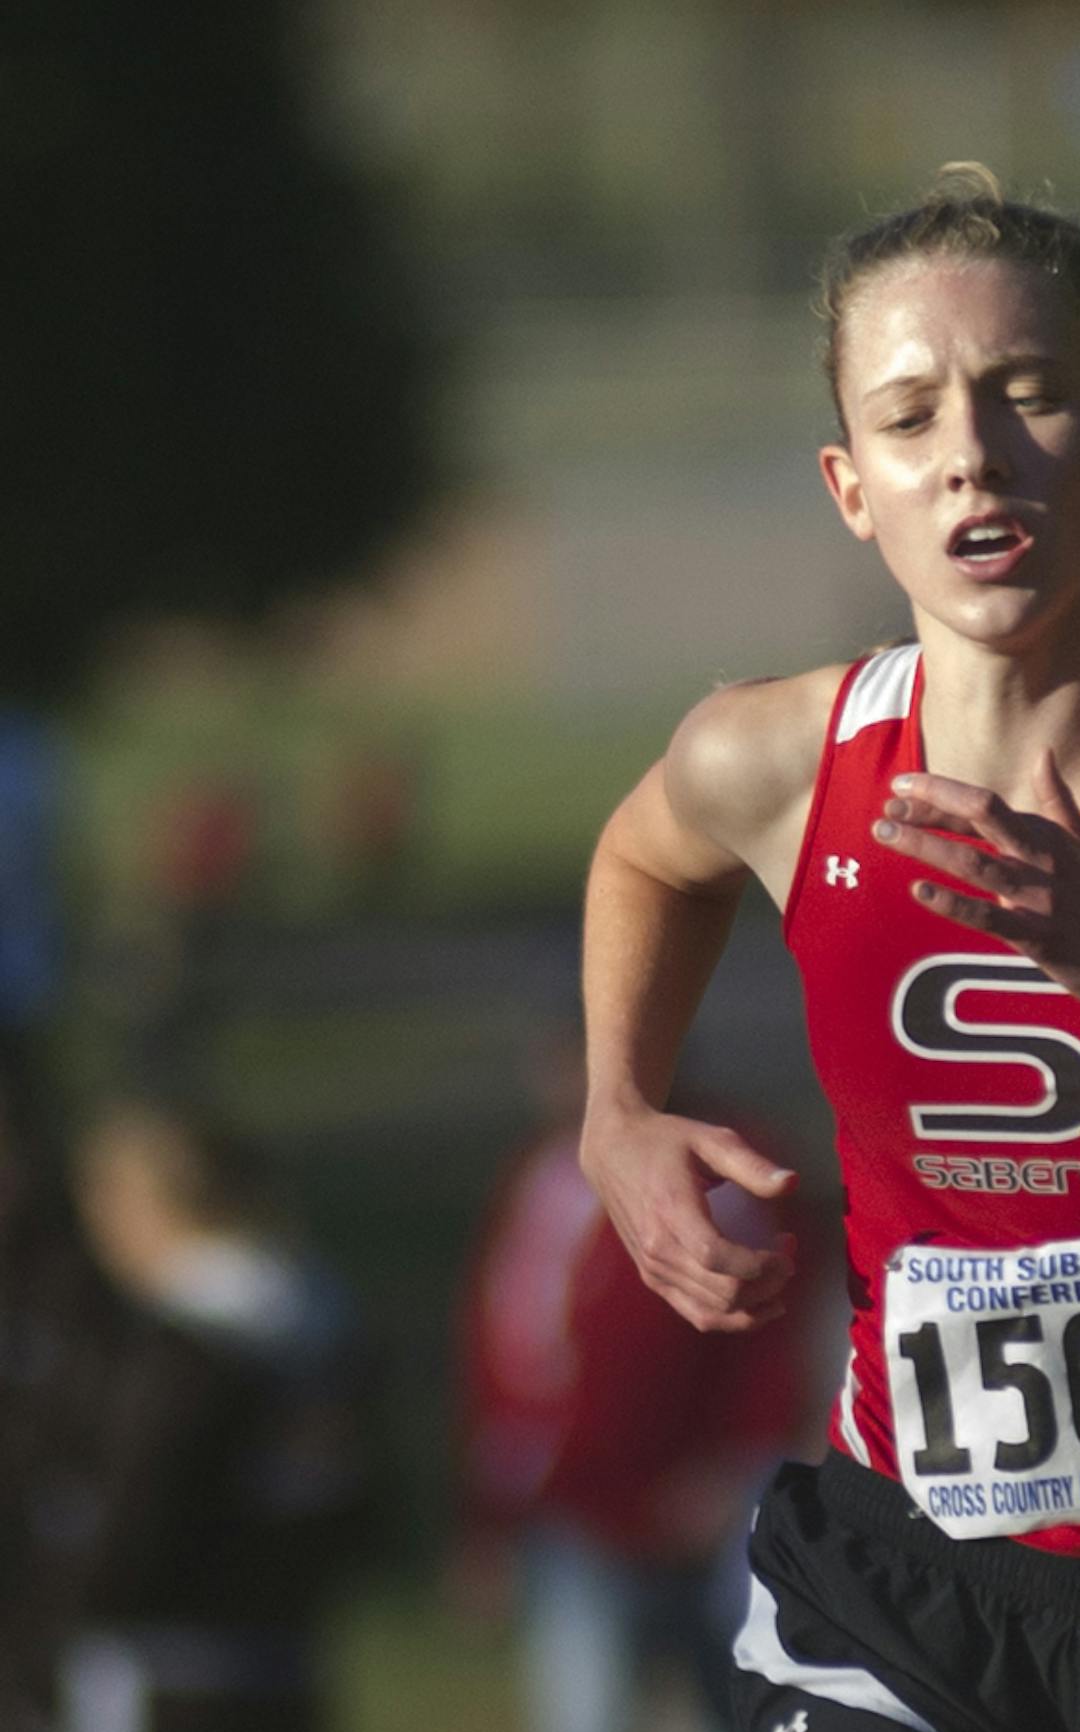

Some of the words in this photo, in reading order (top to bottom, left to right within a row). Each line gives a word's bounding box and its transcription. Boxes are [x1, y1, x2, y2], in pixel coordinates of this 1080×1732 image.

[907, 1256, 1004, 1283] SOUTH
[928, 1484, 987, 1518] CROSS
[992, 1476, 1074, 1514] COUNTRY
